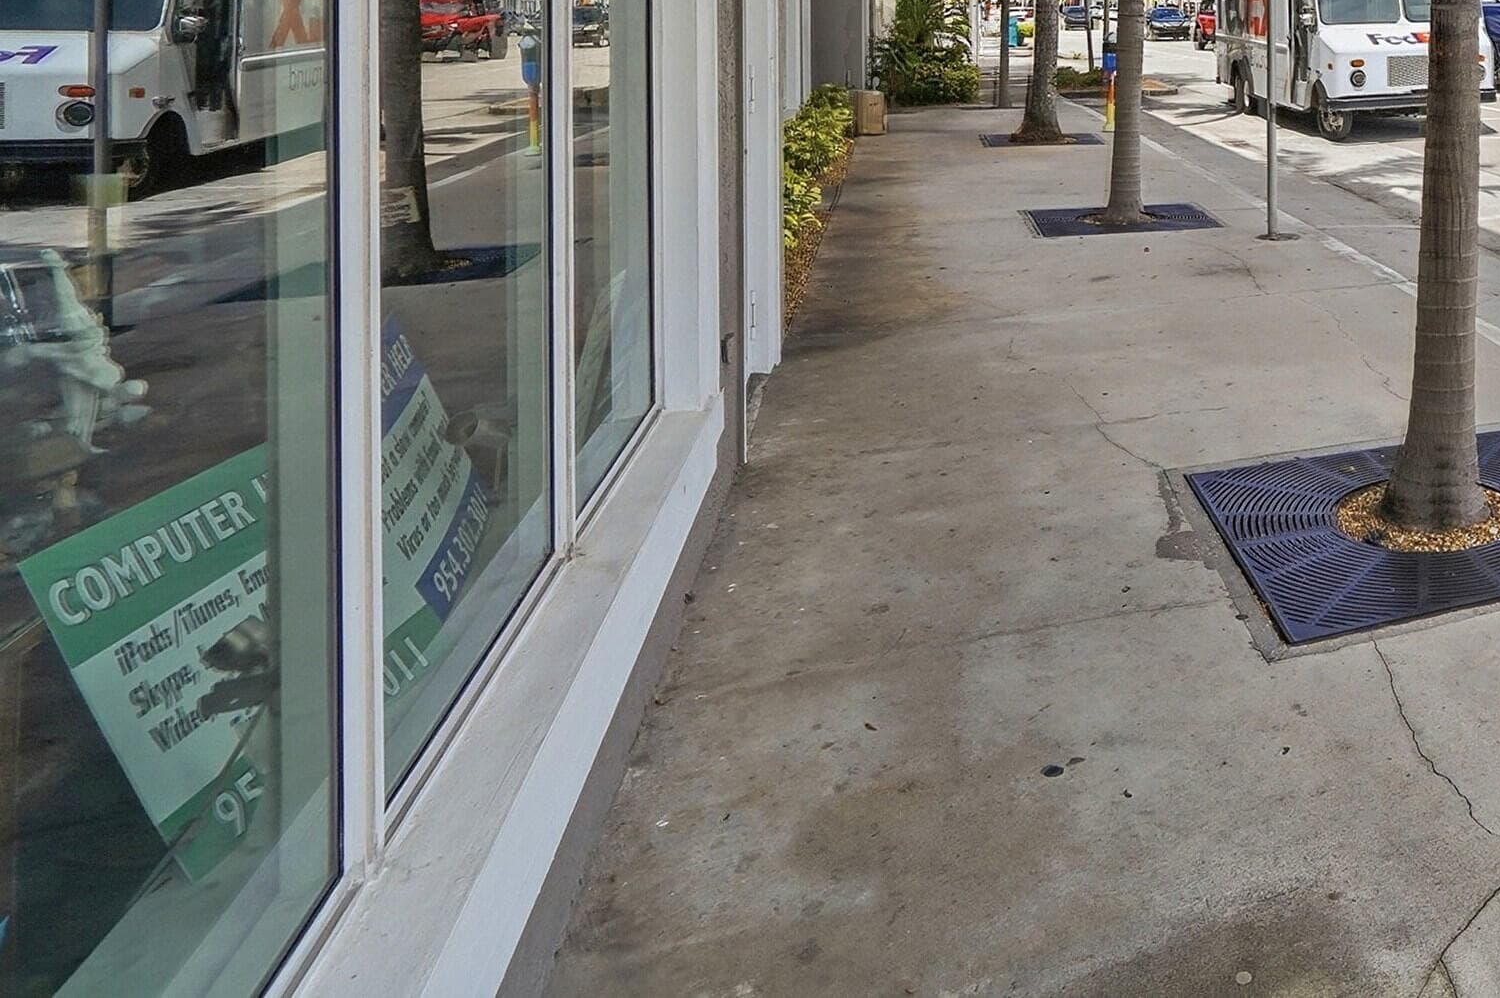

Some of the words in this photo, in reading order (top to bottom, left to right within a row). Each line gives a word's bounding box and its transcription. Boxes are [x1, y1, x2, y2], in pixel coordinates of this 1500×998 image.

[1366, 32, 1431, 46] FedE
[49, 490, 258, 627] COMPUTER
[396, 525, 424, 561] Virus
[421, 512, 432, 533] or
[128, 664, 199, 719] Skype,
[148, 705, 209, 753] Vide
